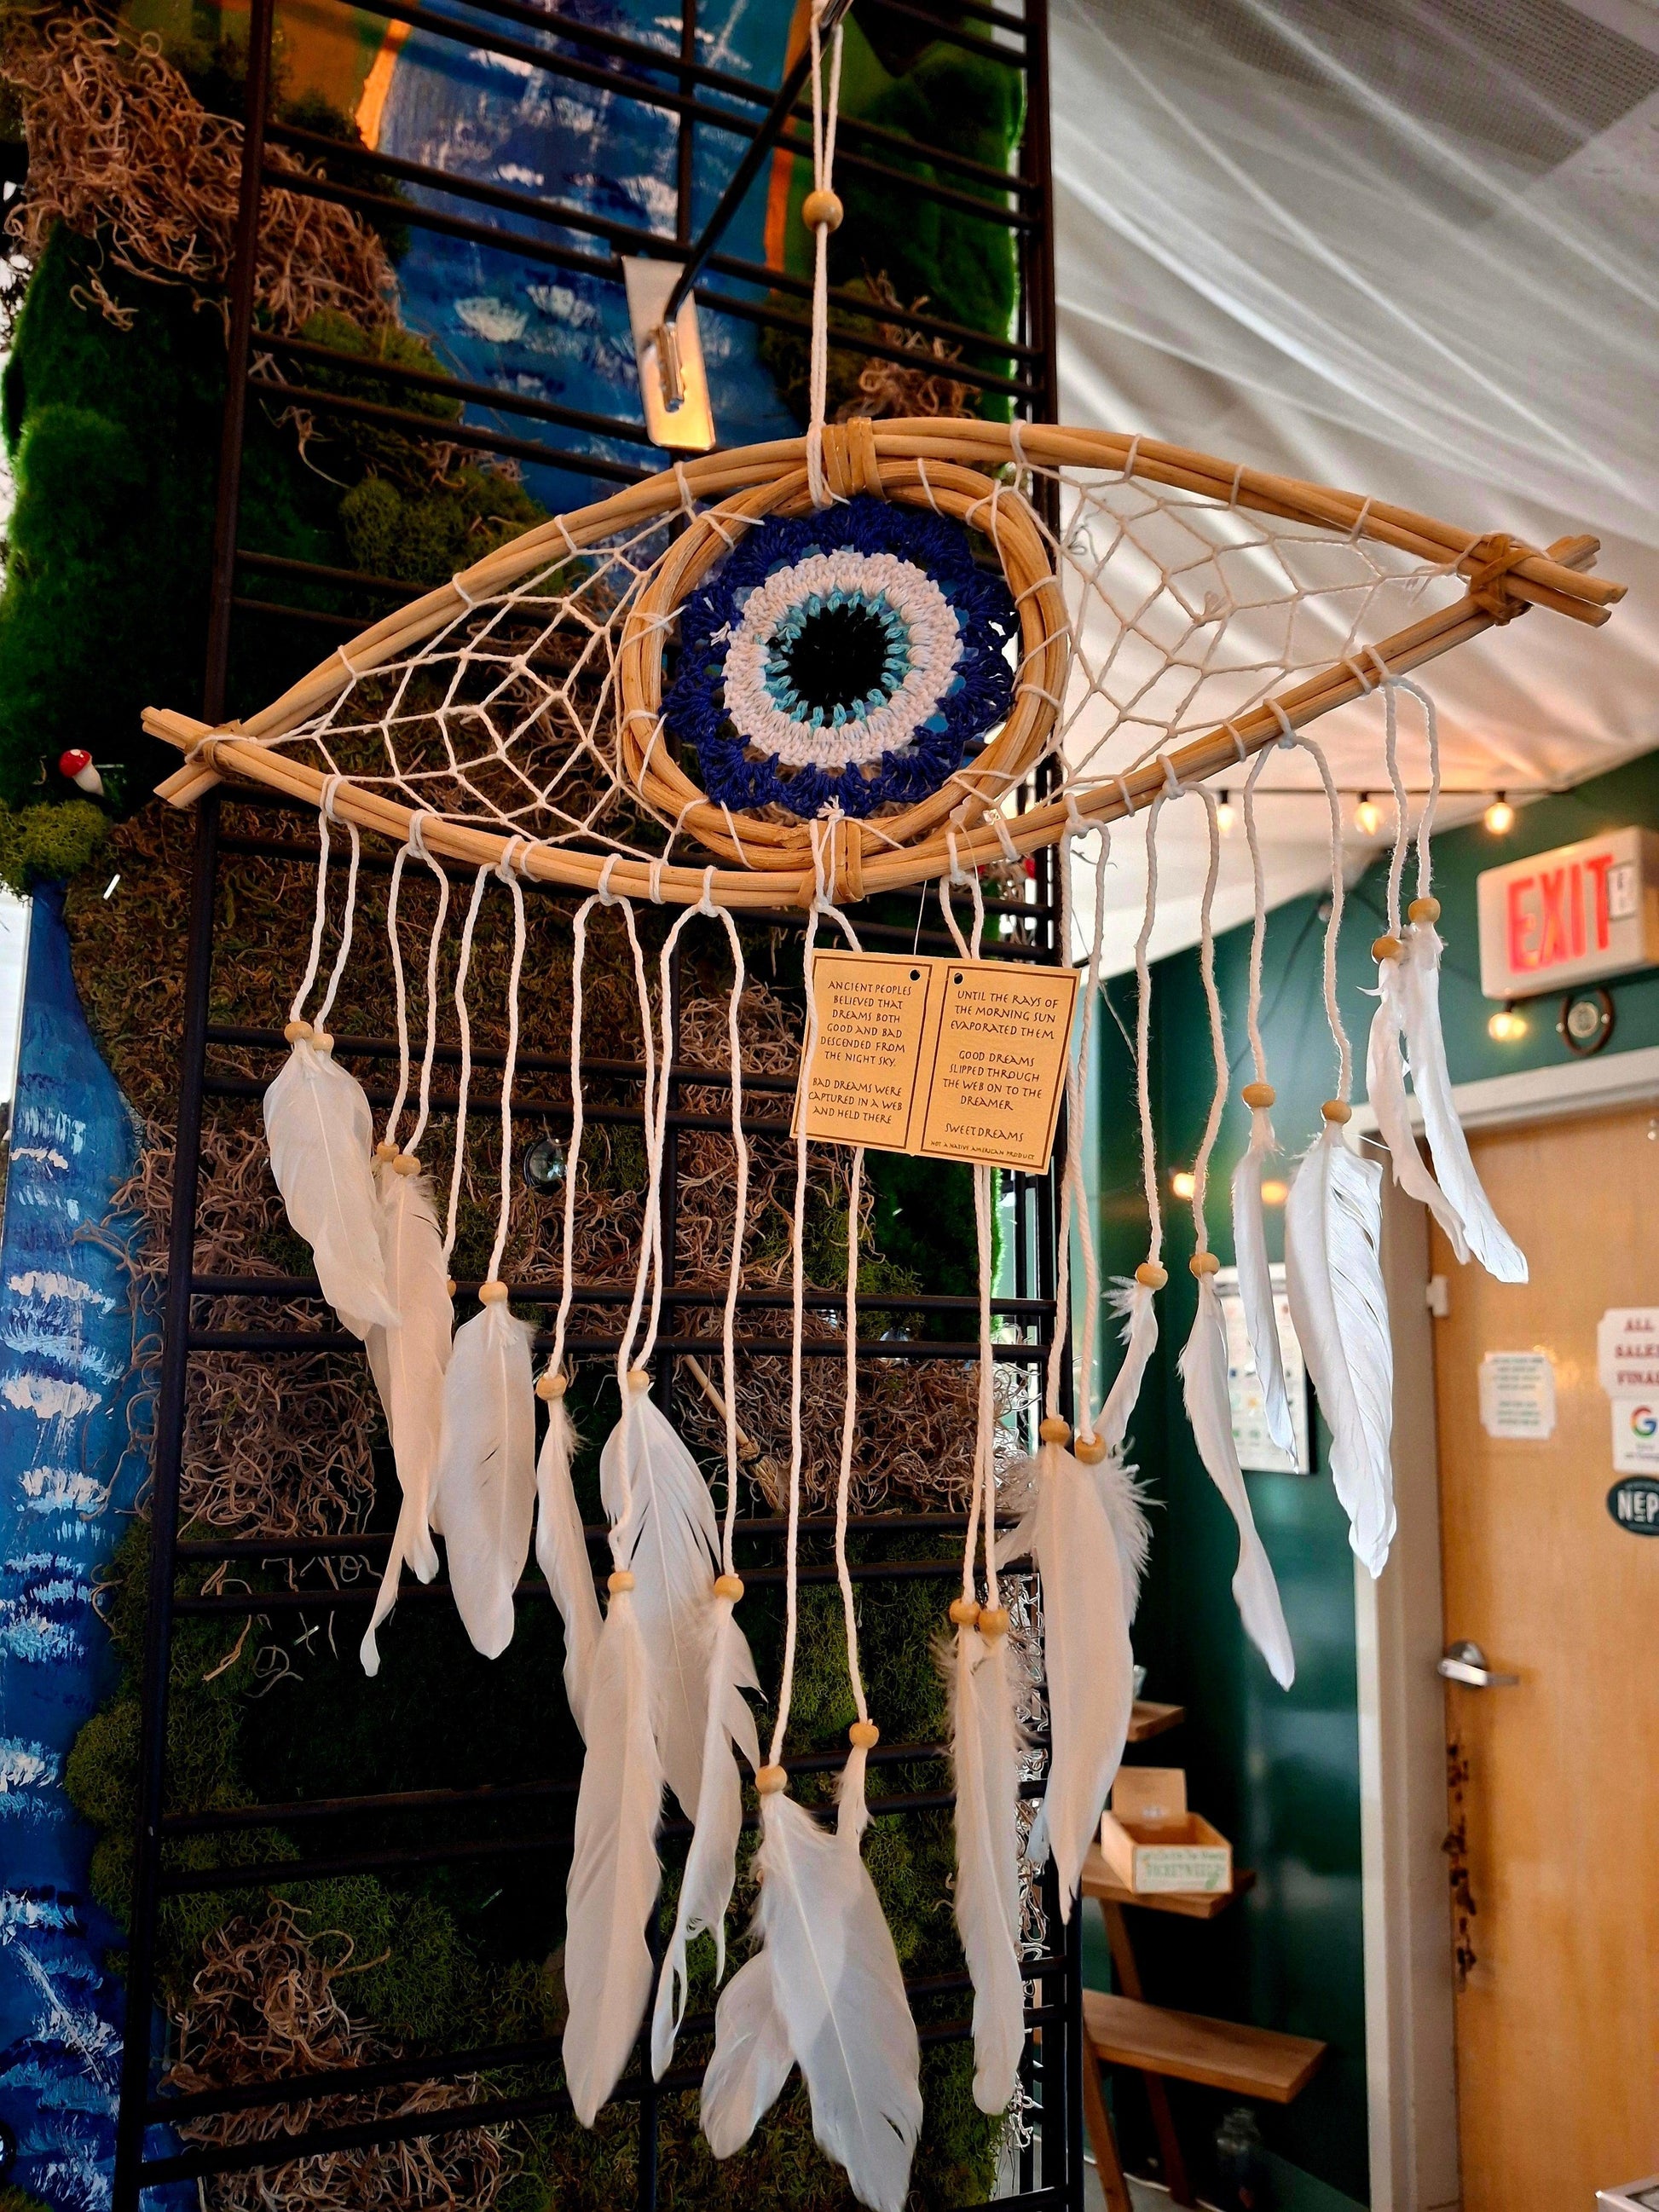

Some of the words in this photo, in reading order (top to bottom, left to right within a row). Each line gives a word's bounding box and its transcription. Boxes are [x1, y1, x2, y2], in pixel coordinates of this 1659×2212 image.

[1507, 855, 1613, 973] EXIT
[828, 981, 873, 992] ANCIENT
[876, 985, 911, 996] PEOPLES
[834, 996, 874, 1007] BELIEVED
[878, 999, 903, 1009] THAT
[957, 990, 986, 1001] UNTIL
[990, 993, 1009, 1002] THE
[1012, 995, 1042, 1008] RAYS
[1045, 999, 1059, 1008] OF
[832, 1009, 871, 1021] DREAMS
[876, 1014, 900, 1023] BOTH
[955, 1005, 972, 1015] THE
[975, 1008, 1030, 1021] MORNING
[1033, 1012, 1055, 1023] SUN
[827, 1023, 853, 1033] GOOD
[855, 1026, 877, 1036] AND
[882, 1029, 902, 1038] BAD
[951, 1020, 1017, 1035] EVAPORATED
[1021, 1027, 1055, 1040] THEM
[820, 1037, 871, 1049] DESCENDED
[876, 1042, 905, 1053] FROM
[825, 1051, 843, 1060] THE
[845, 1053, 876, 1064] NIGHT
[959, 1050, 985, 1060] GOOD
[989, 1053, 1035, 1066] DREAMS
[949, 1064, 984, 1076] SLIPPED
[987, 1068, 1040, 1083] THROUGH
[812, 1077, 830, 1088] BAD
[834, 1080, 872, 1093] DREAMS
[875, 1084, 902, 1096] WERE
[943, 1078, 960, 1089] THE
[962, 1080, 984, 1091] WEB
[987, 1084, 1003, 1094] ON
[1006, 1085, 1019, 1095] TO
[1023, 1088, 1043, 1099] THE
[808, 1091, 854, 1105] CAPTURED
[858, 1098, 868, 1107] IN
[870, 1099, 879, 1108] A
[882, 1100, 903, 1111] WEB
[960, 1095, 1014, 1111] DREAMER
[812, 1106, 835, 1116] AND
[837, 1109, 859, 1120] HELD
[863, 1112, 892, 1124] THERE
[971, 1146, 1004, 1155] AMERICAN
[1006, 1151, 1035, 1160] PRODUCT
[1624, 1318, 1655, 1331] ALL
[1630, 1406, 1657, 1438] G
